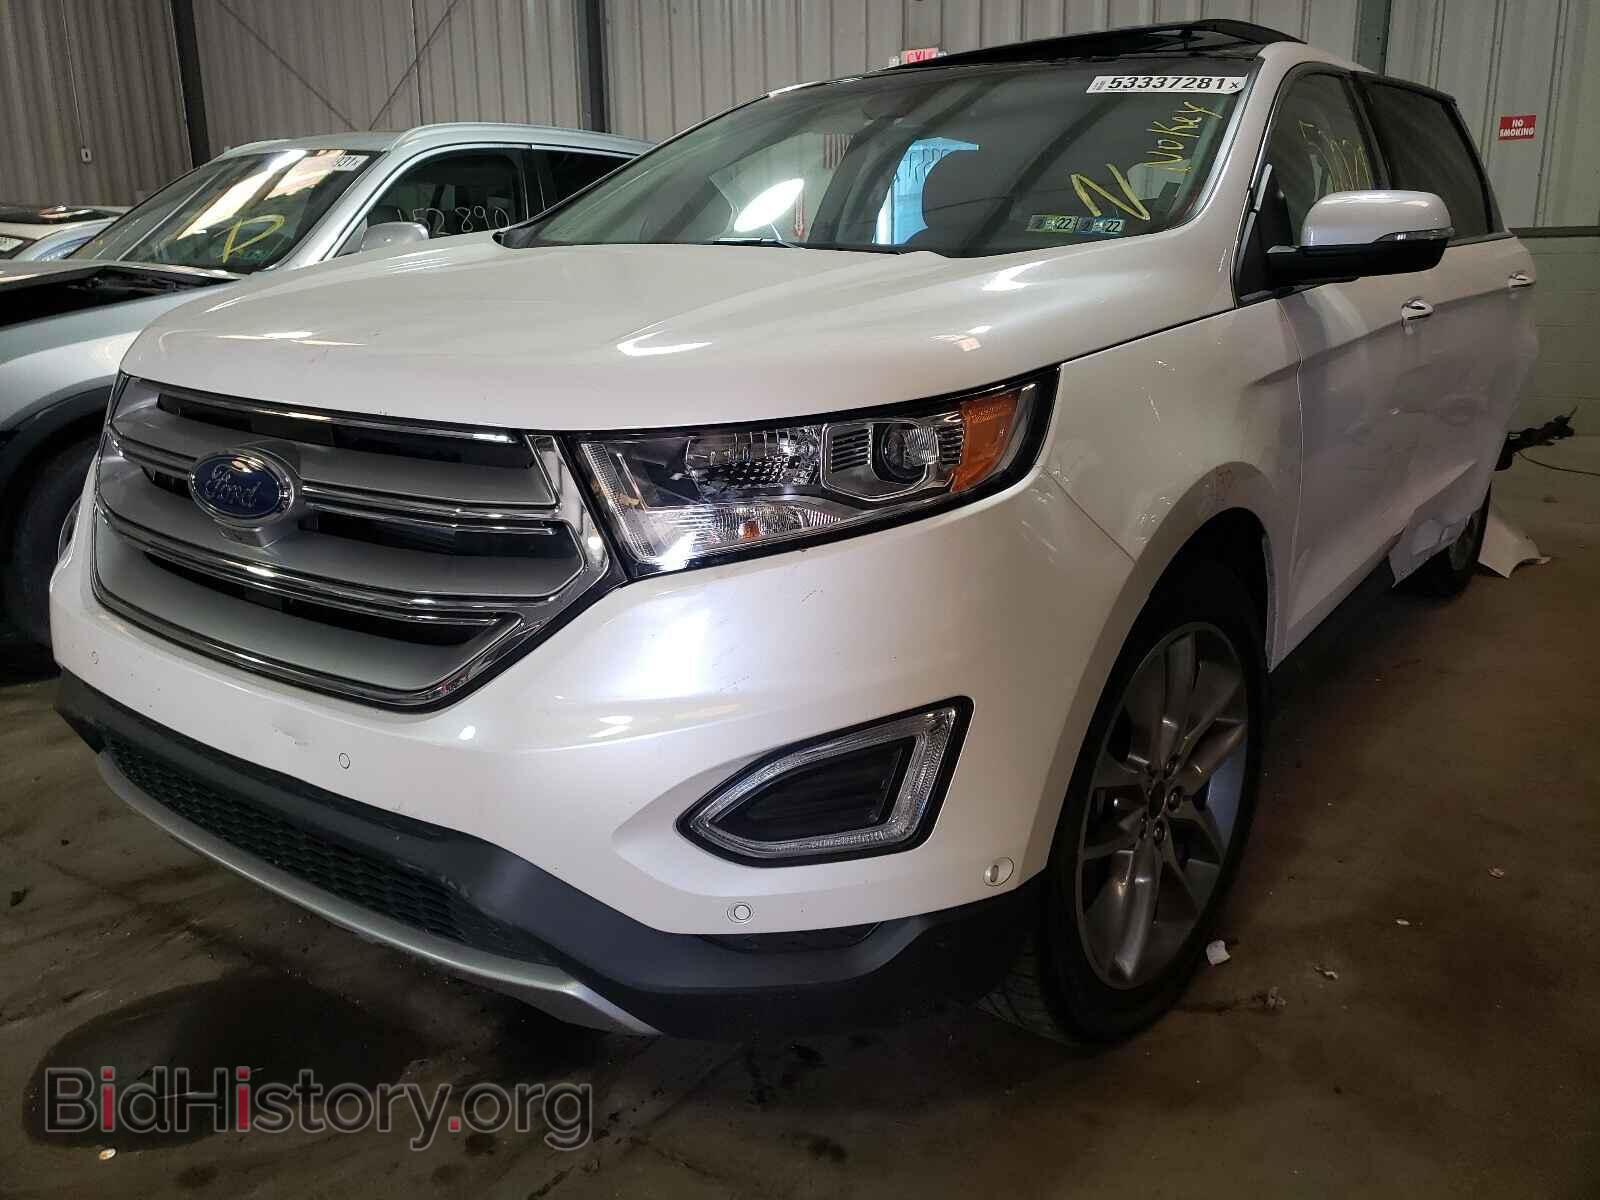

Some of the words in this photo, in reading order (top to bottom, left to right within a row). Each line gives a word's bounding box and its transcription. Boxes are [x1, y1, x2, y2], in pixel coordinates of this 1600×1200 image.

[1107, 76, 1226, 90] 53337281
[1512, 119, 1524, 128] NO
[1499, 127, 1534, 137] SMOKING
[1056, 217, 1072, 230] 22
[1105, 220, 1120, 233] 22
[204, 463, 263, 508] Ford
